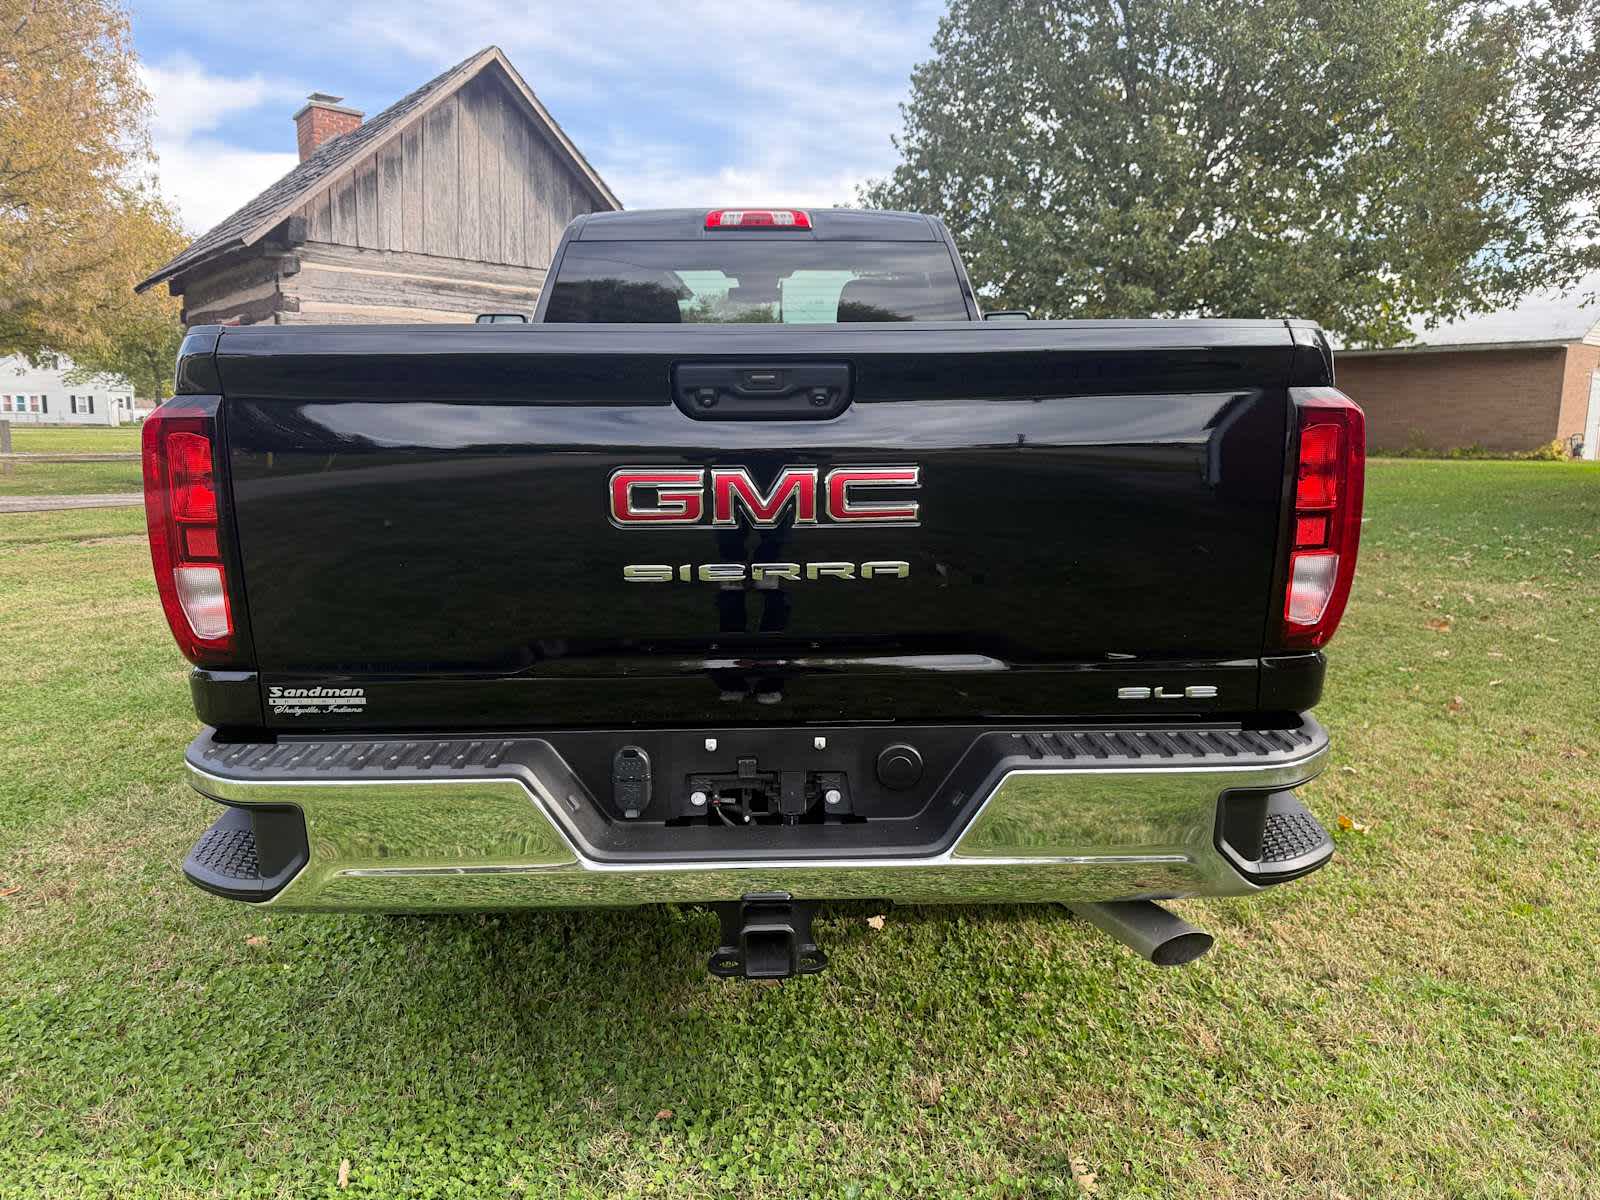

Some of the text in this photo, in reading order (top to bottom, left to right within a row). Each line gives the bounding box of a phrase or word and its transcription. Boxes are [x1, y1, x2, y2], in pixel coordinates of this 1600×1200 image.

[608, 465, 921, 529] GMC
[623, 561, 910, 582] SIERRA
[268, 686, 364, 697] Sandman
[1117, 686, 1218, 699] SLE
